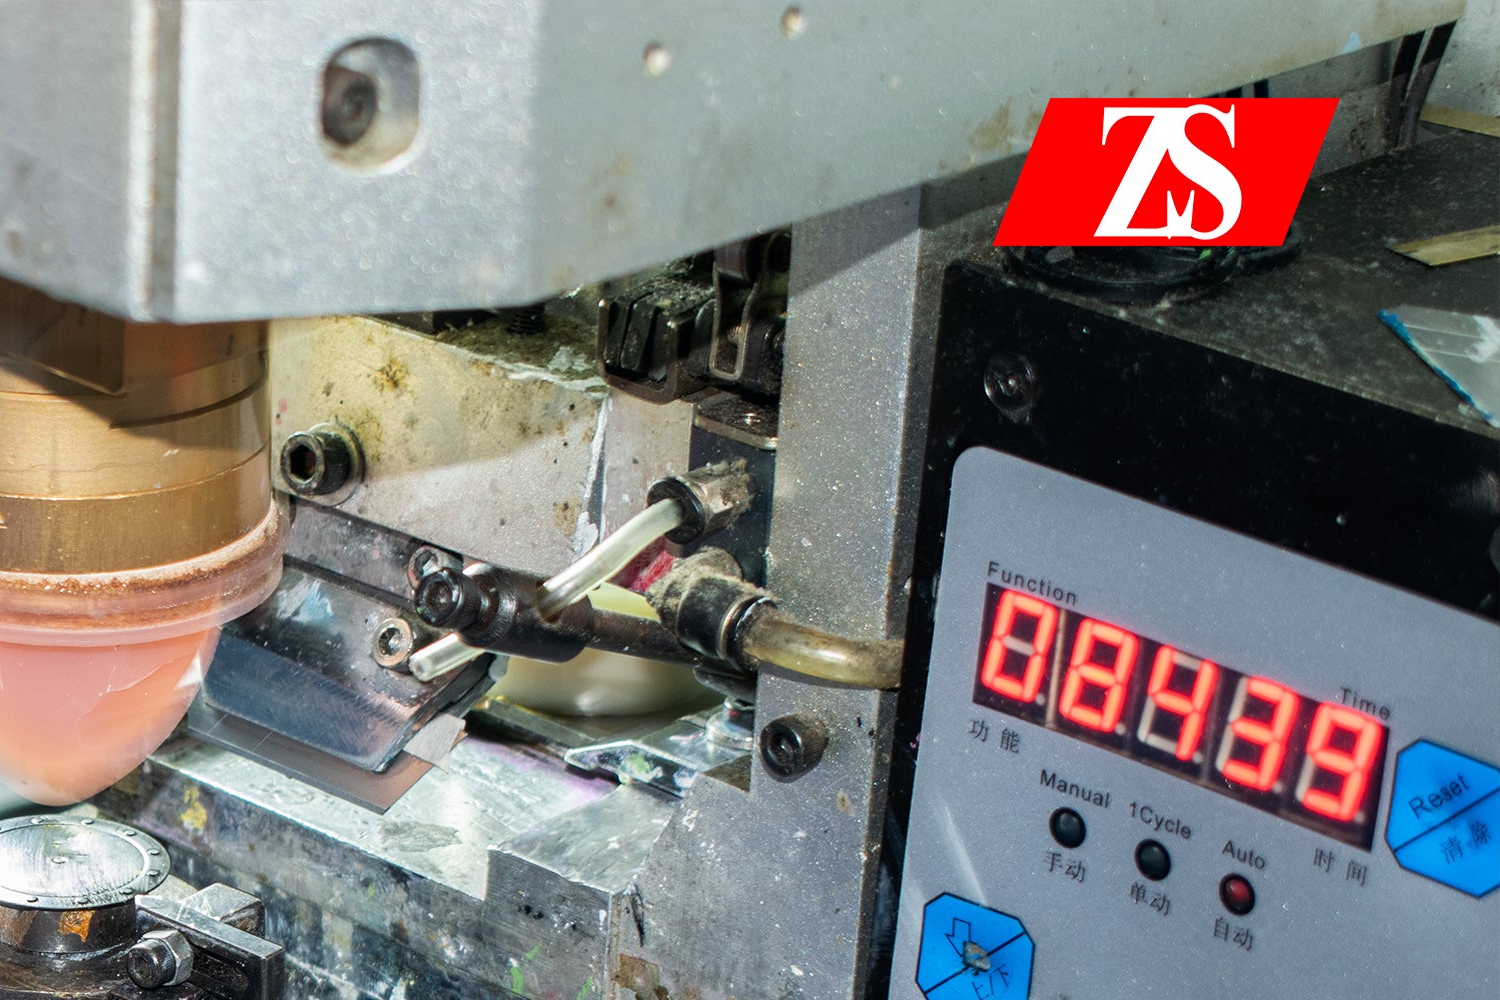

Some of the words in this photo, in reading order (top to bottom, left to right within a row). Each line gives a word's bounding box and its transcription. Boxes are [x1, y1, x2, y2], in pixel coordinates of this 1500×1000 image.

[987, 560, 1077, 606] Function
[1339, 686, 1391, 720] Time
[968, 718, 1021, 754] 功能
[1039, 768, 1110, 809] Manual
[1408, 773, 1470, 820] Reset
[1129, 801, 1192, 840] 1Cycle
[1222, 839, 1266, 871] Auto
[1440, 820, 1492, 865] 清除
[1045, 850, 1087, 884] 手动
[1313, 848, 1368, 887] 时间
[1129, 881, 1171, 916] 单动
[1213, 916, 1254, 951] 自动
